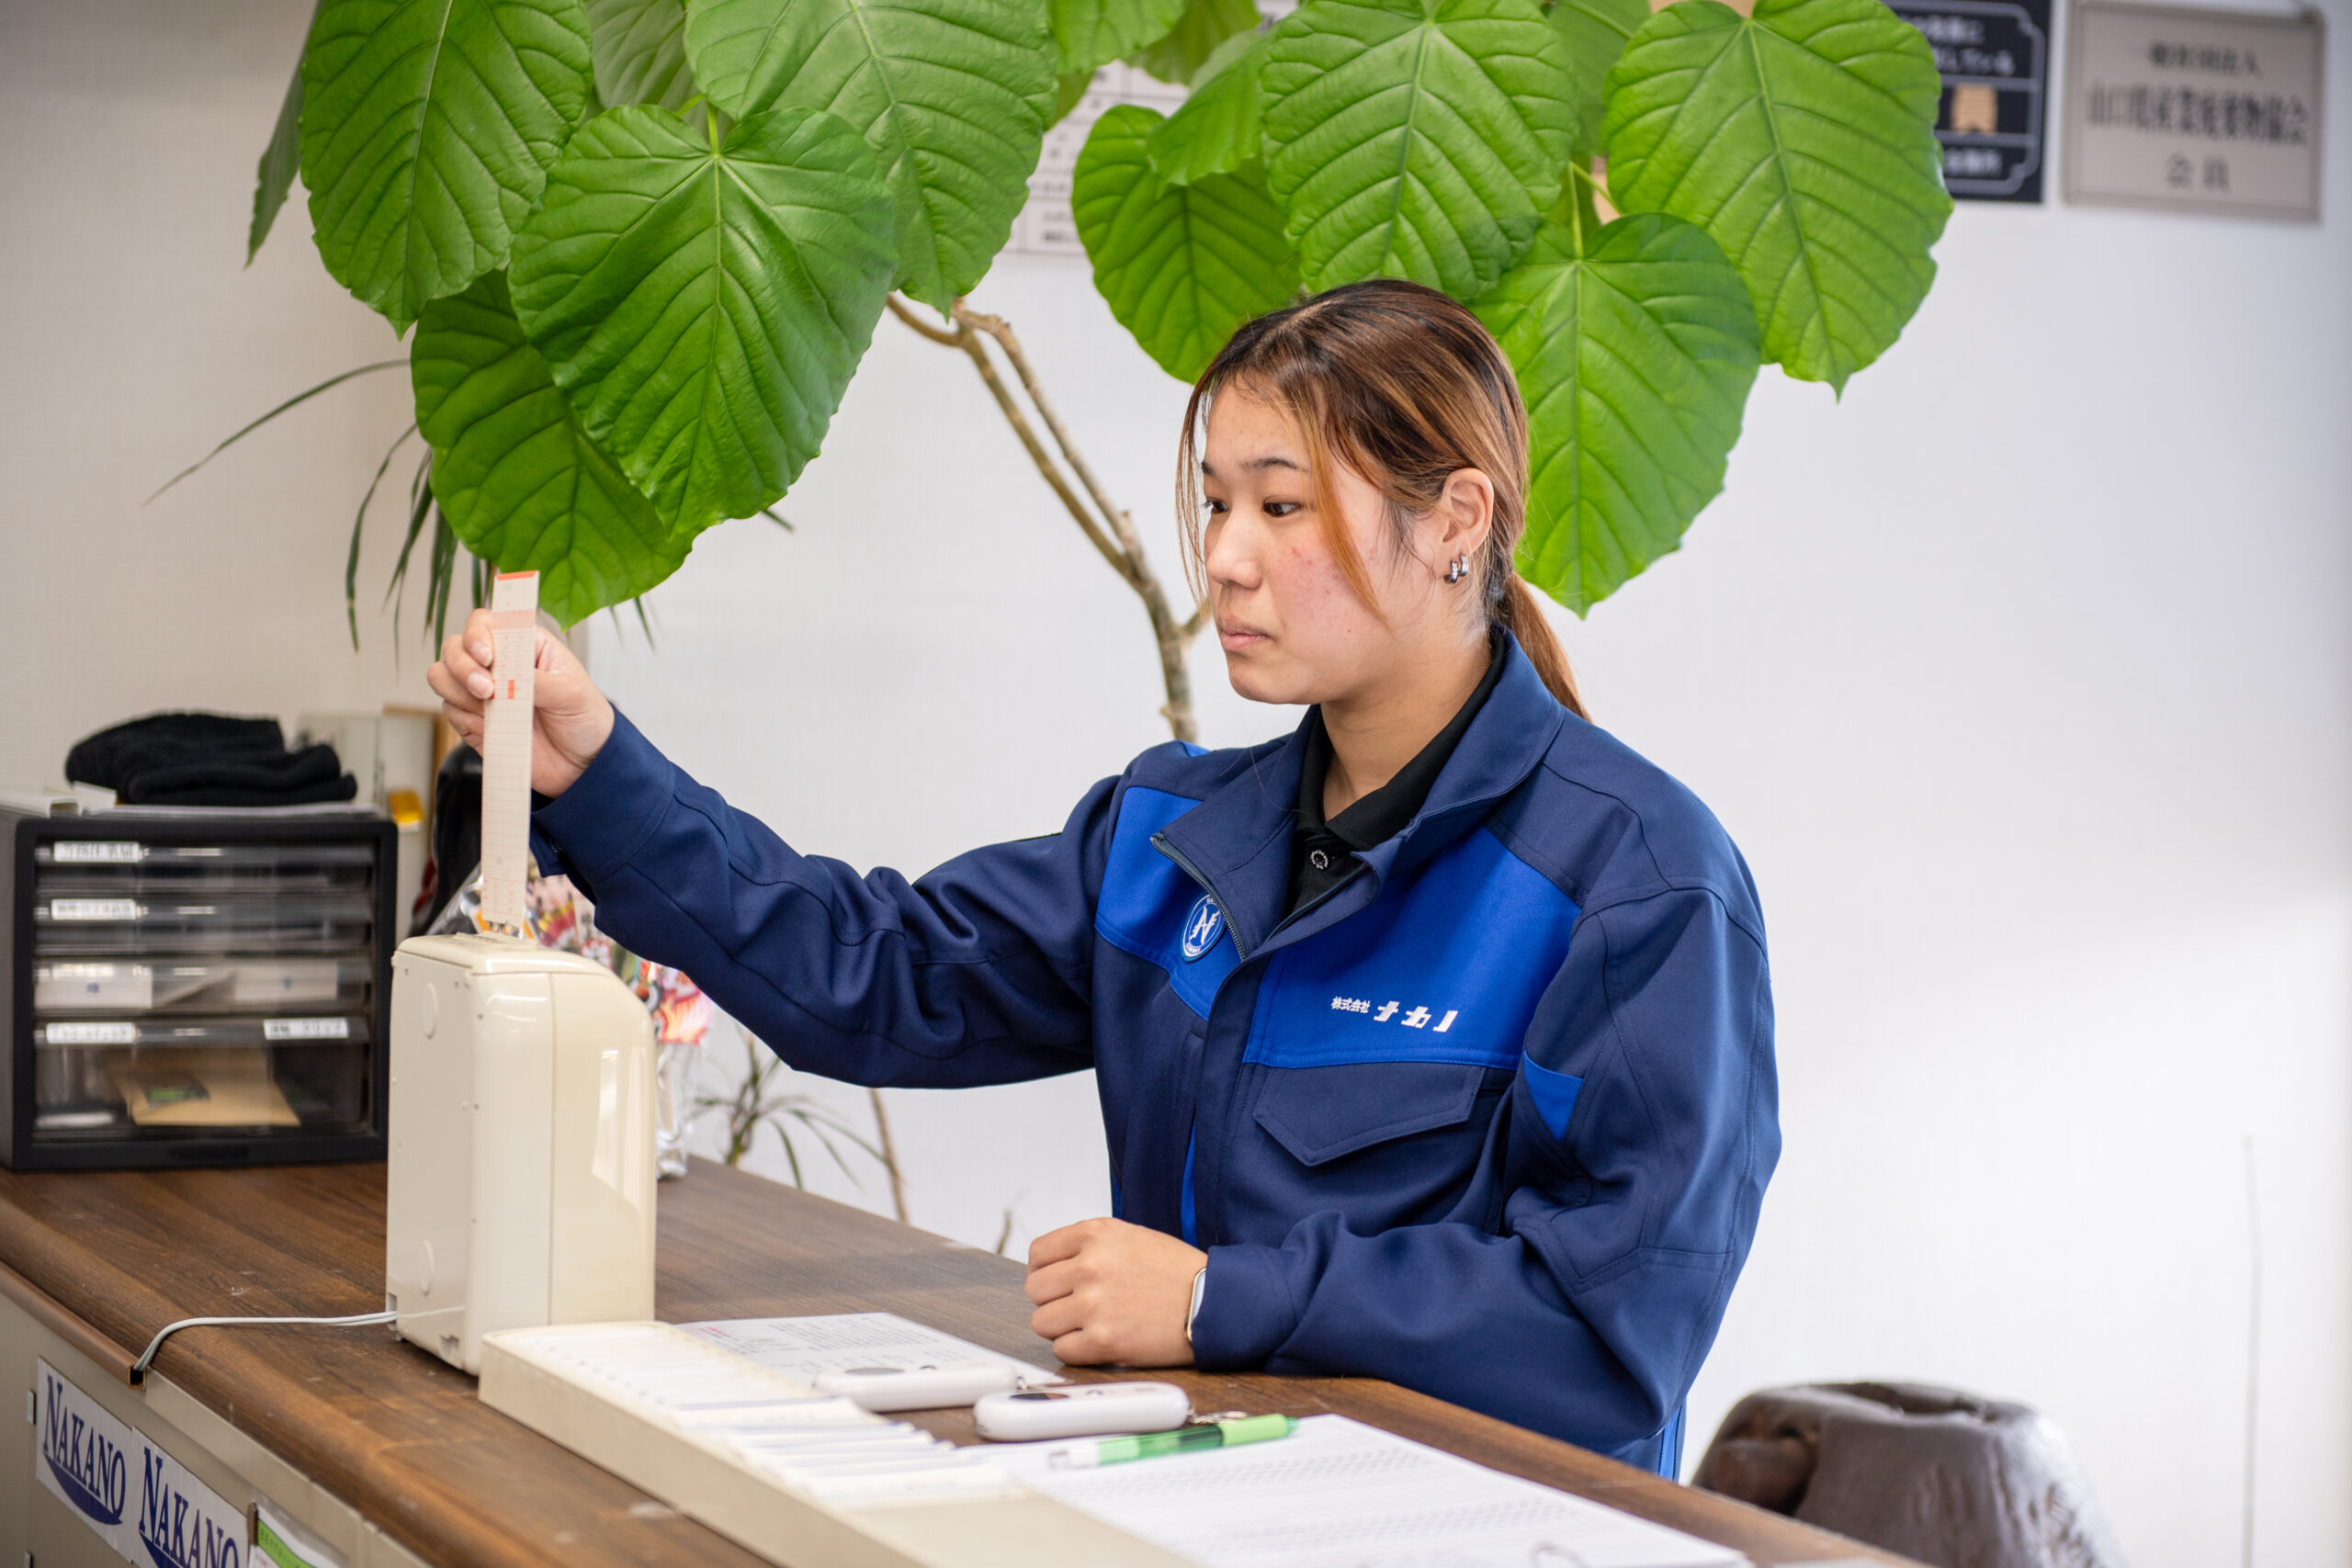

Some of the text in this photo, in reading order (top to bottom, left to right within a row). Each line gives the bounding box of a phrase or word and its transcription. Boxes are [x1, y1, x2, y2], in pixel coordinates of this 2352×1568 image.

[1330, 996, 1459, 1032] 株式会社 ナカノ
[43, 1374, 127, 1519] NAKANO
